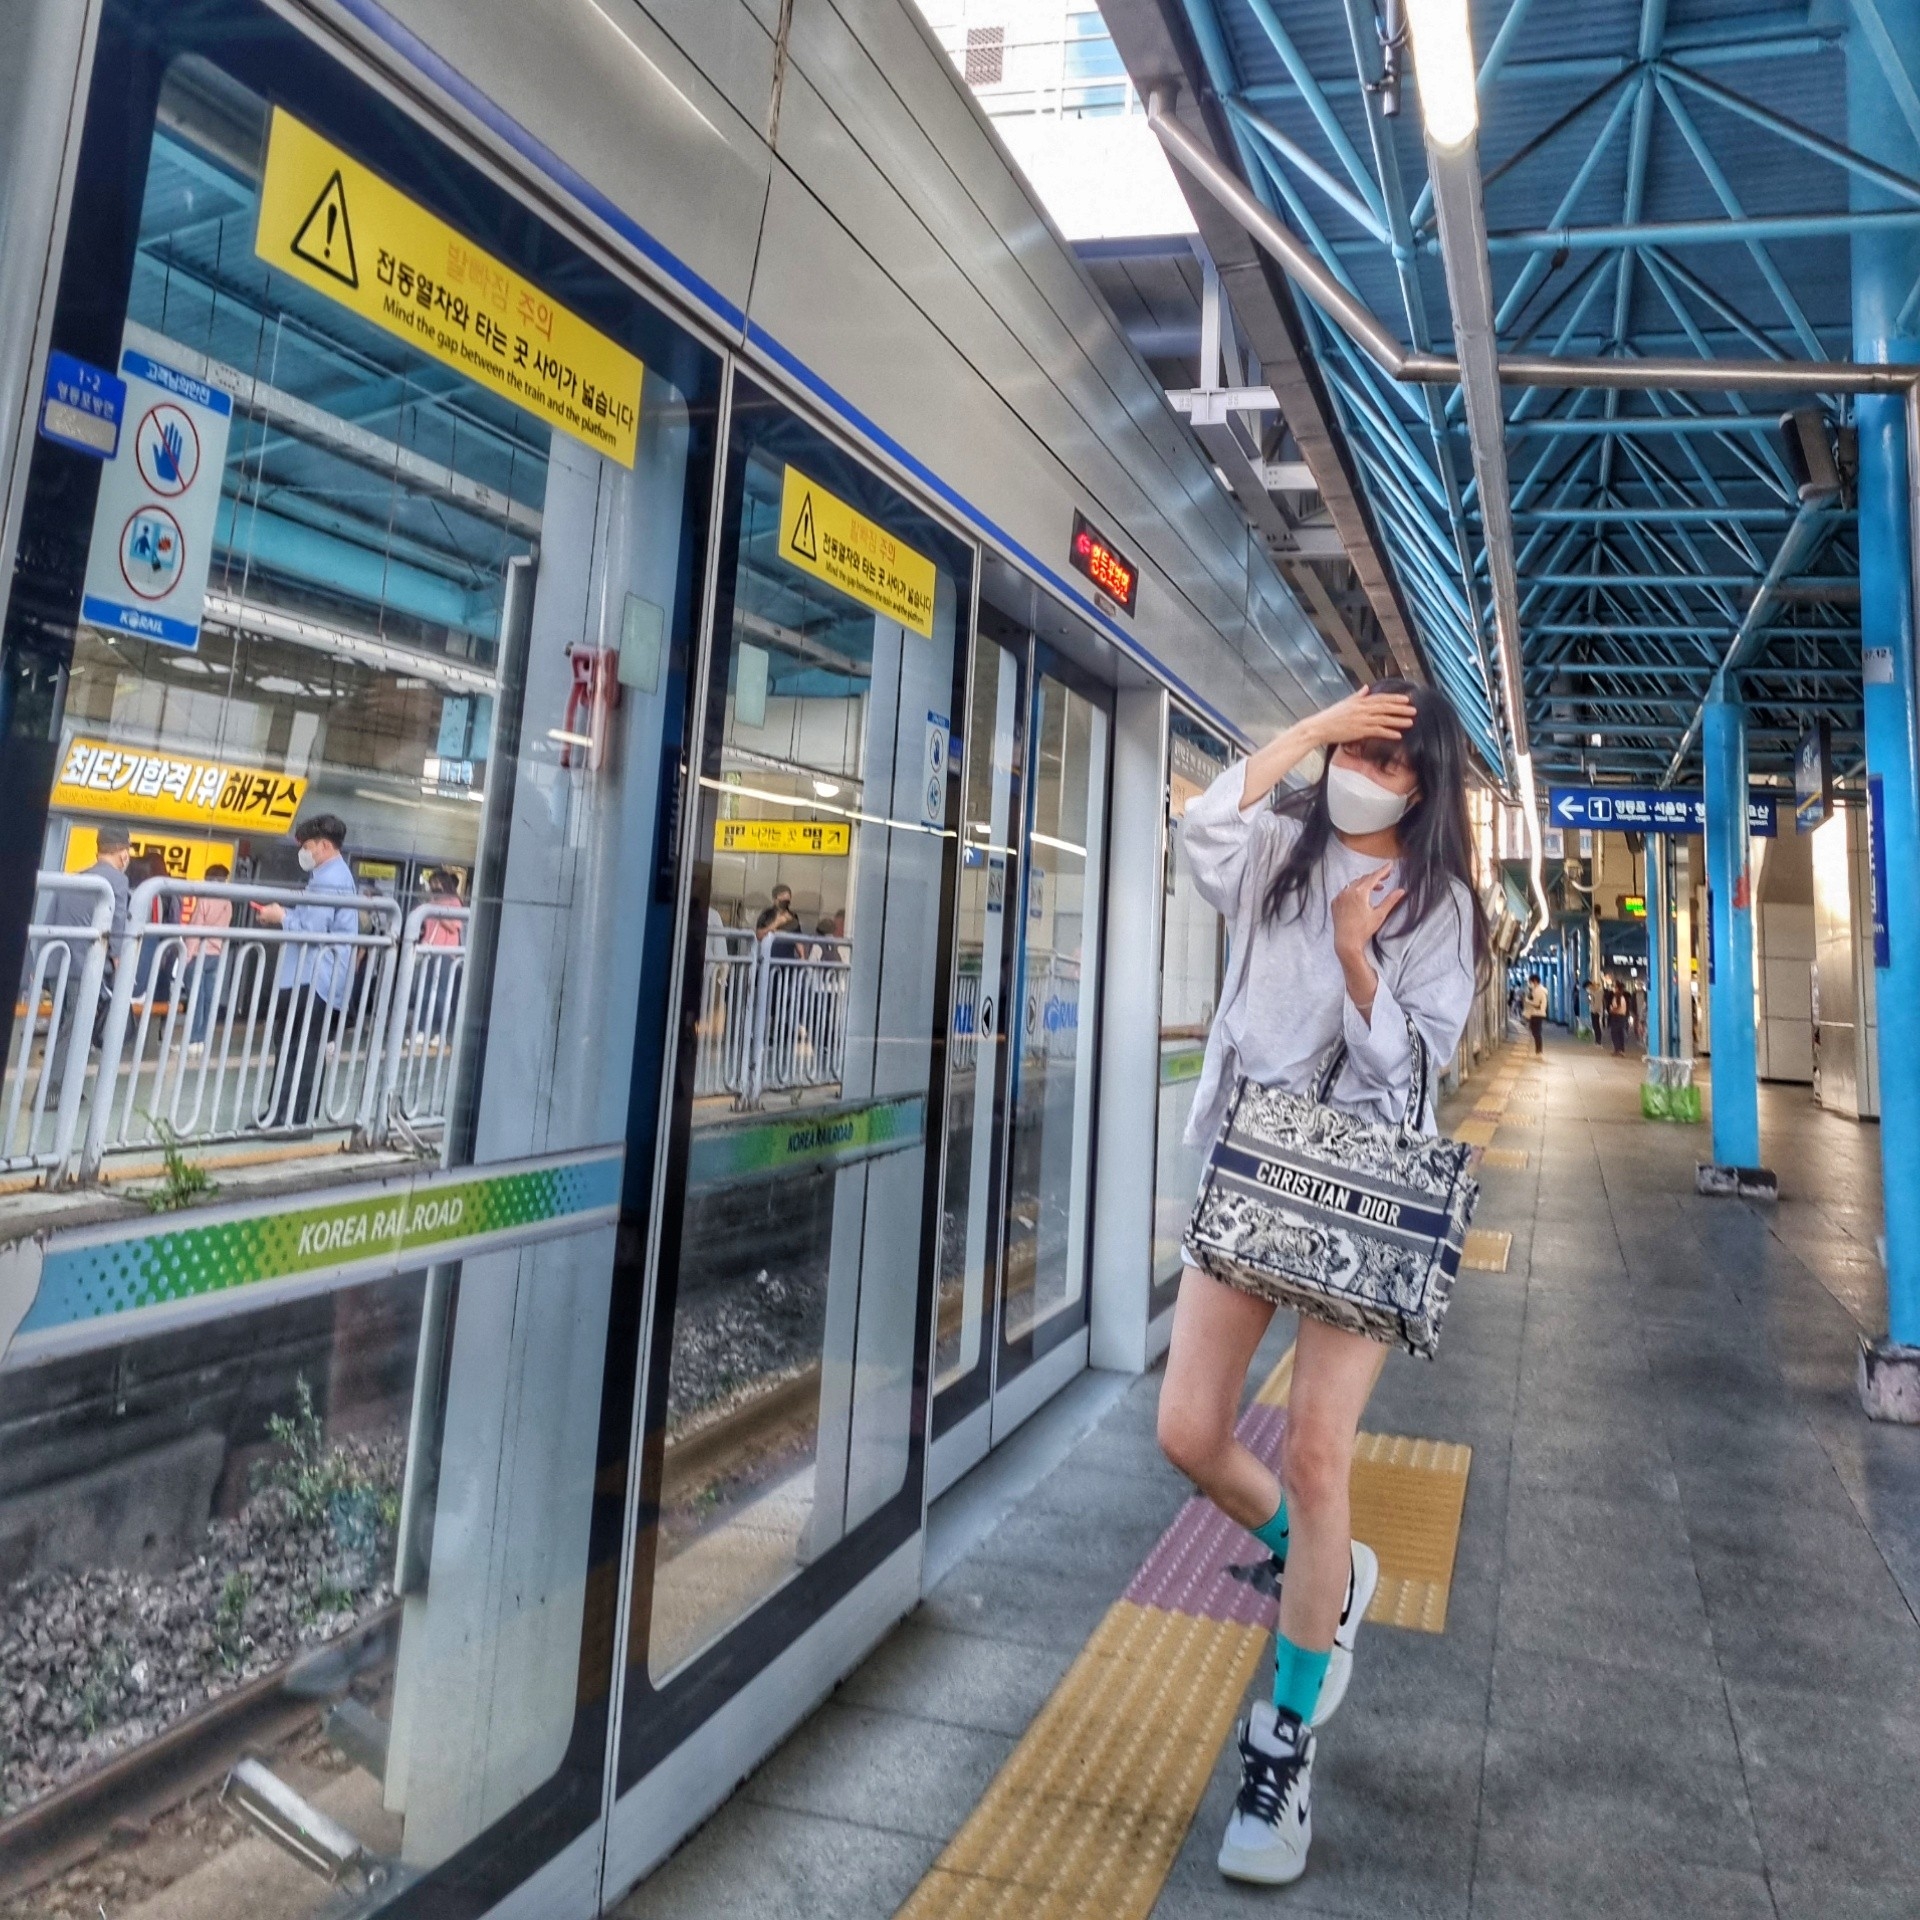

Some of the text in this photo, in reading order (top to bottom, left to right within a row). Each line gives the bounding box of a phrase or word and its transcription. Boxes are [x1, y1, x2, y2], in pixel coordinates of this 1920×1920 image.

[516, 289, 553, 342] 주의
[377, 248, 634, 434] 전동열차와 타는 곳 사이가 넓습니다
[383, 294, 617, 447] Mind the gap between the train and the platform
[862, 556, 876, 583] 타는
[220, 772, 297, 818] 해커스
[1594, 800, 1604, 819] 1
[1256, 1161, 1401, 1228] CHRISTIAN DIOR
[298, 1213, 367, 1257] KOREA
